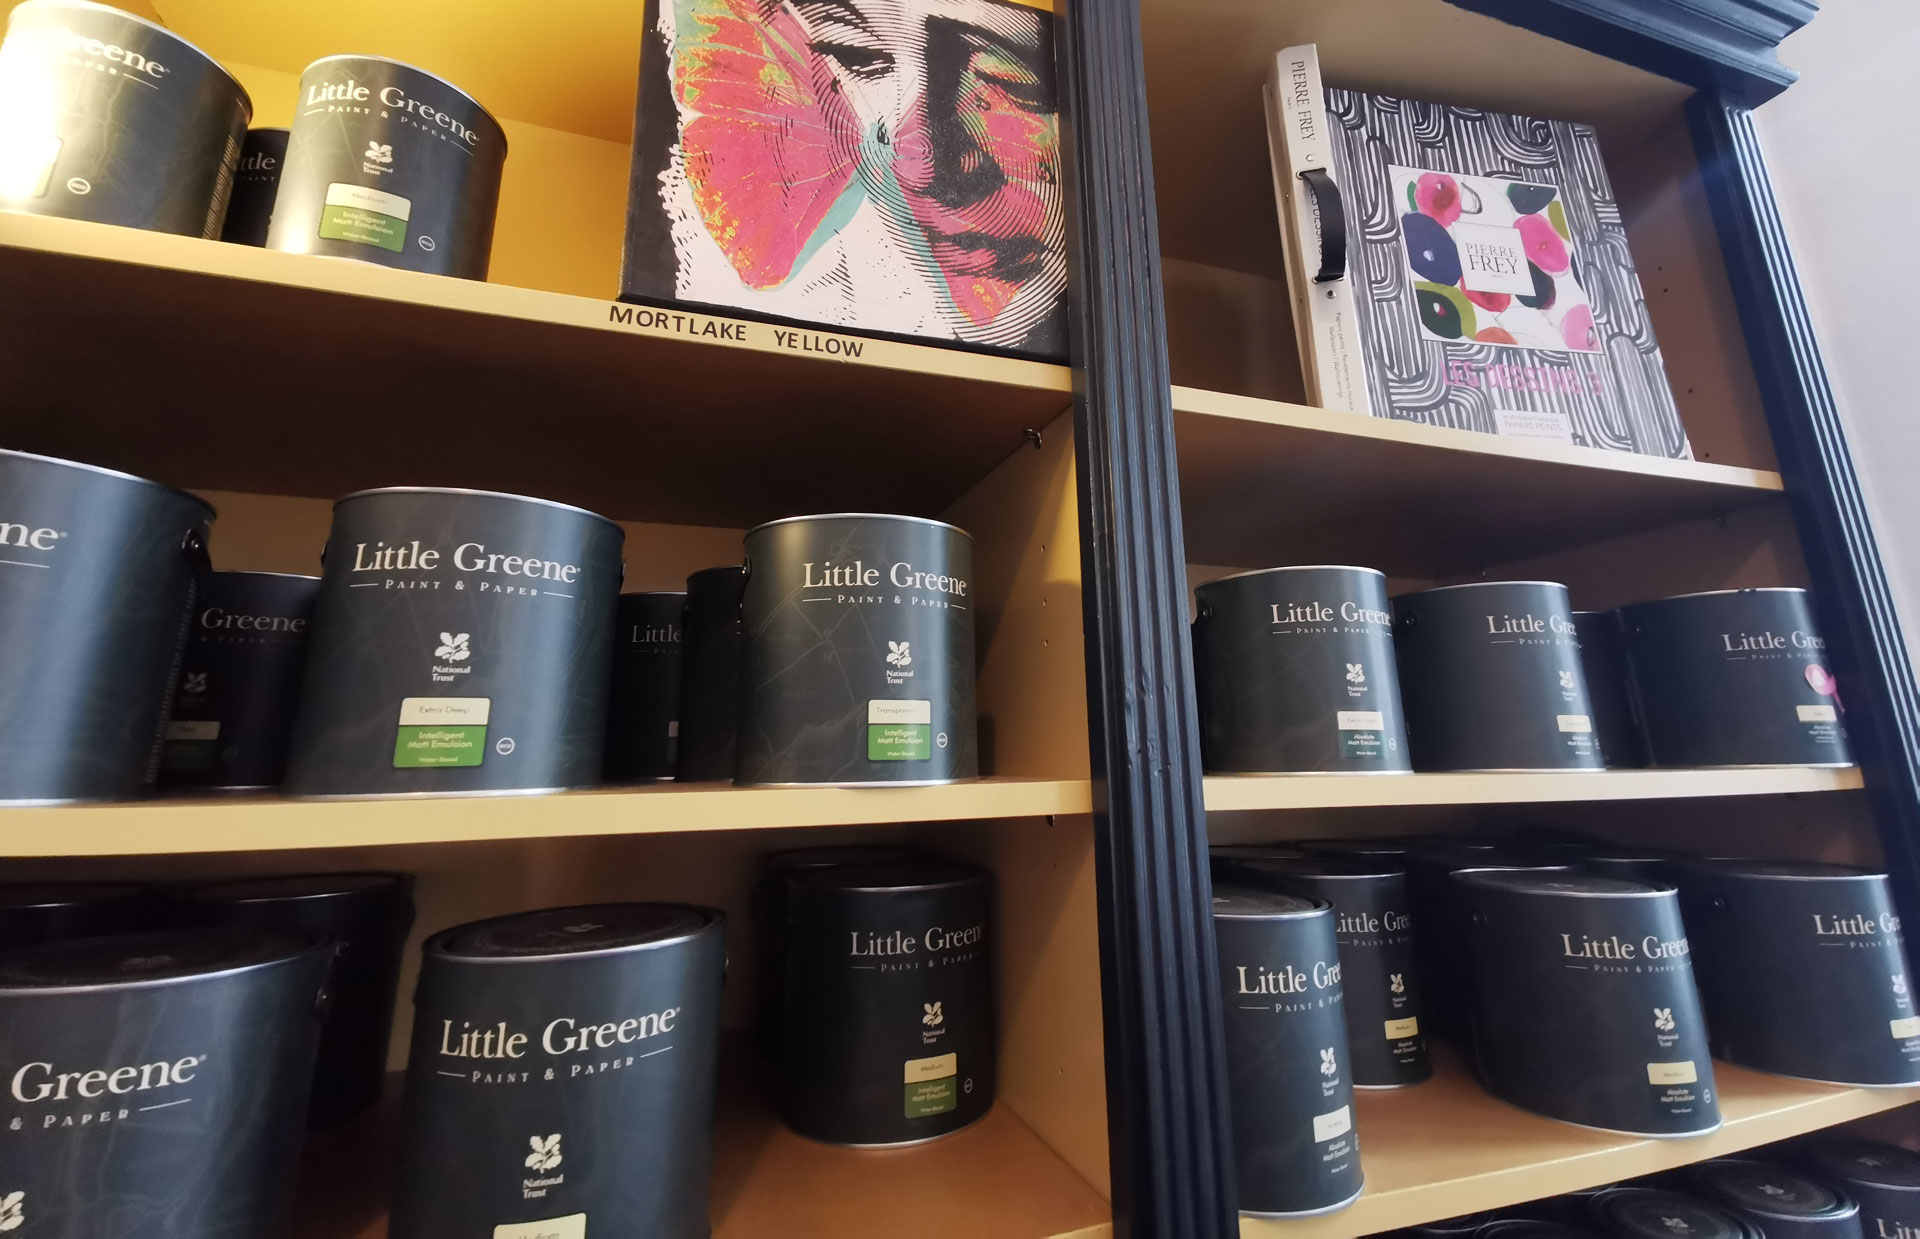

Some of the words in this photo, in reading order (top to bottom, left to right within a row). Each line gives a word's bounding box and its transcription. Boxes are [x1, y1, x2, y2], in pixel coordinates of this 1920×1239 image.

[1291, 60, 1309, 107] PIERRE
[306, 80, 370, 106] Little
[380, 87, 477, 145] Greene
[328, 104, 371, 115] PAINT
[381, 110, 389, 119] &
[401, 116, 447, 142] PAPER
[1299, 109, 1316, 141] FREY
[332, 217, 353, 226] Matt
[354, 219, 394, 236] Emulsion
[343, 211, 386, 226] Intelligent
[1466, 243, 1517, 258] PIERRE
[1469, 255, 1517, 274] FREY
[609, 305, 747, 341] MORTLAKE
[774, 329, 864, 358] YELLOW
[1440, 360, 1480, 387] LES
[1485, 364, 1582, 394] DESSINS
[0, 522, 59, 550] ne
[352, 541, 440, 571] Little
[454, 543, 577, 583] Greene
[385, 579, 441, 590] PAINT
[455, 581, 465, 590] &
[480, 582, 538, 596] PAPER
[803, 560, 879, 588] Little
[890, 562, 966, 597] Greene
[837, 595, 884, 604] PAINT
[894, 595, 901, 604] &
[912, 596, 949, 608] PAPER
[201, 607, 306, 633] Greene
[1270, 601, 1334, 624] Little
[1486, 614, 1545, 634] Little
[1722, 631, 1786, 651] Little
[432, 665, 470, 674] National
[432, 673, 454, 682] Trust
[445, 706, 470, 714] Deep
[419, 732, 464, 740] Intelligent
[884, 729, 917, 737] Intelligent
[407, 741, 428, 749] Matt
[431, 740, 473, 749] Emulsion
[1336, 912, 1379, 933] ittle
[1813, 914, 1876, 936] Little
[850, 930, 916, 956] Little
[1560, 934, 1635, 959] Little
[881, 962, 920, 972] PAINT
[928, 959, 934, 968] &
[1236, 964, 1307, 994] Little
[1275, 1002, 1313, 1013] PAINT
[440, 1019, 529, 1059] Little
[542, 1008, 676, 1055] Greene
[11, 1056, 199, 1103] Greene
[472, 1071, 530, 1083] PAINT
[544, 1068, 554, 1080] &
[571, 1056, 634, 1078] PAPER
[9, 1117, 23, 1131] &
[43, 1109, 129, 1128] PAPER
[522, 1174, 564, 1189] National
[522, 1188, 547, 1199] Trust
